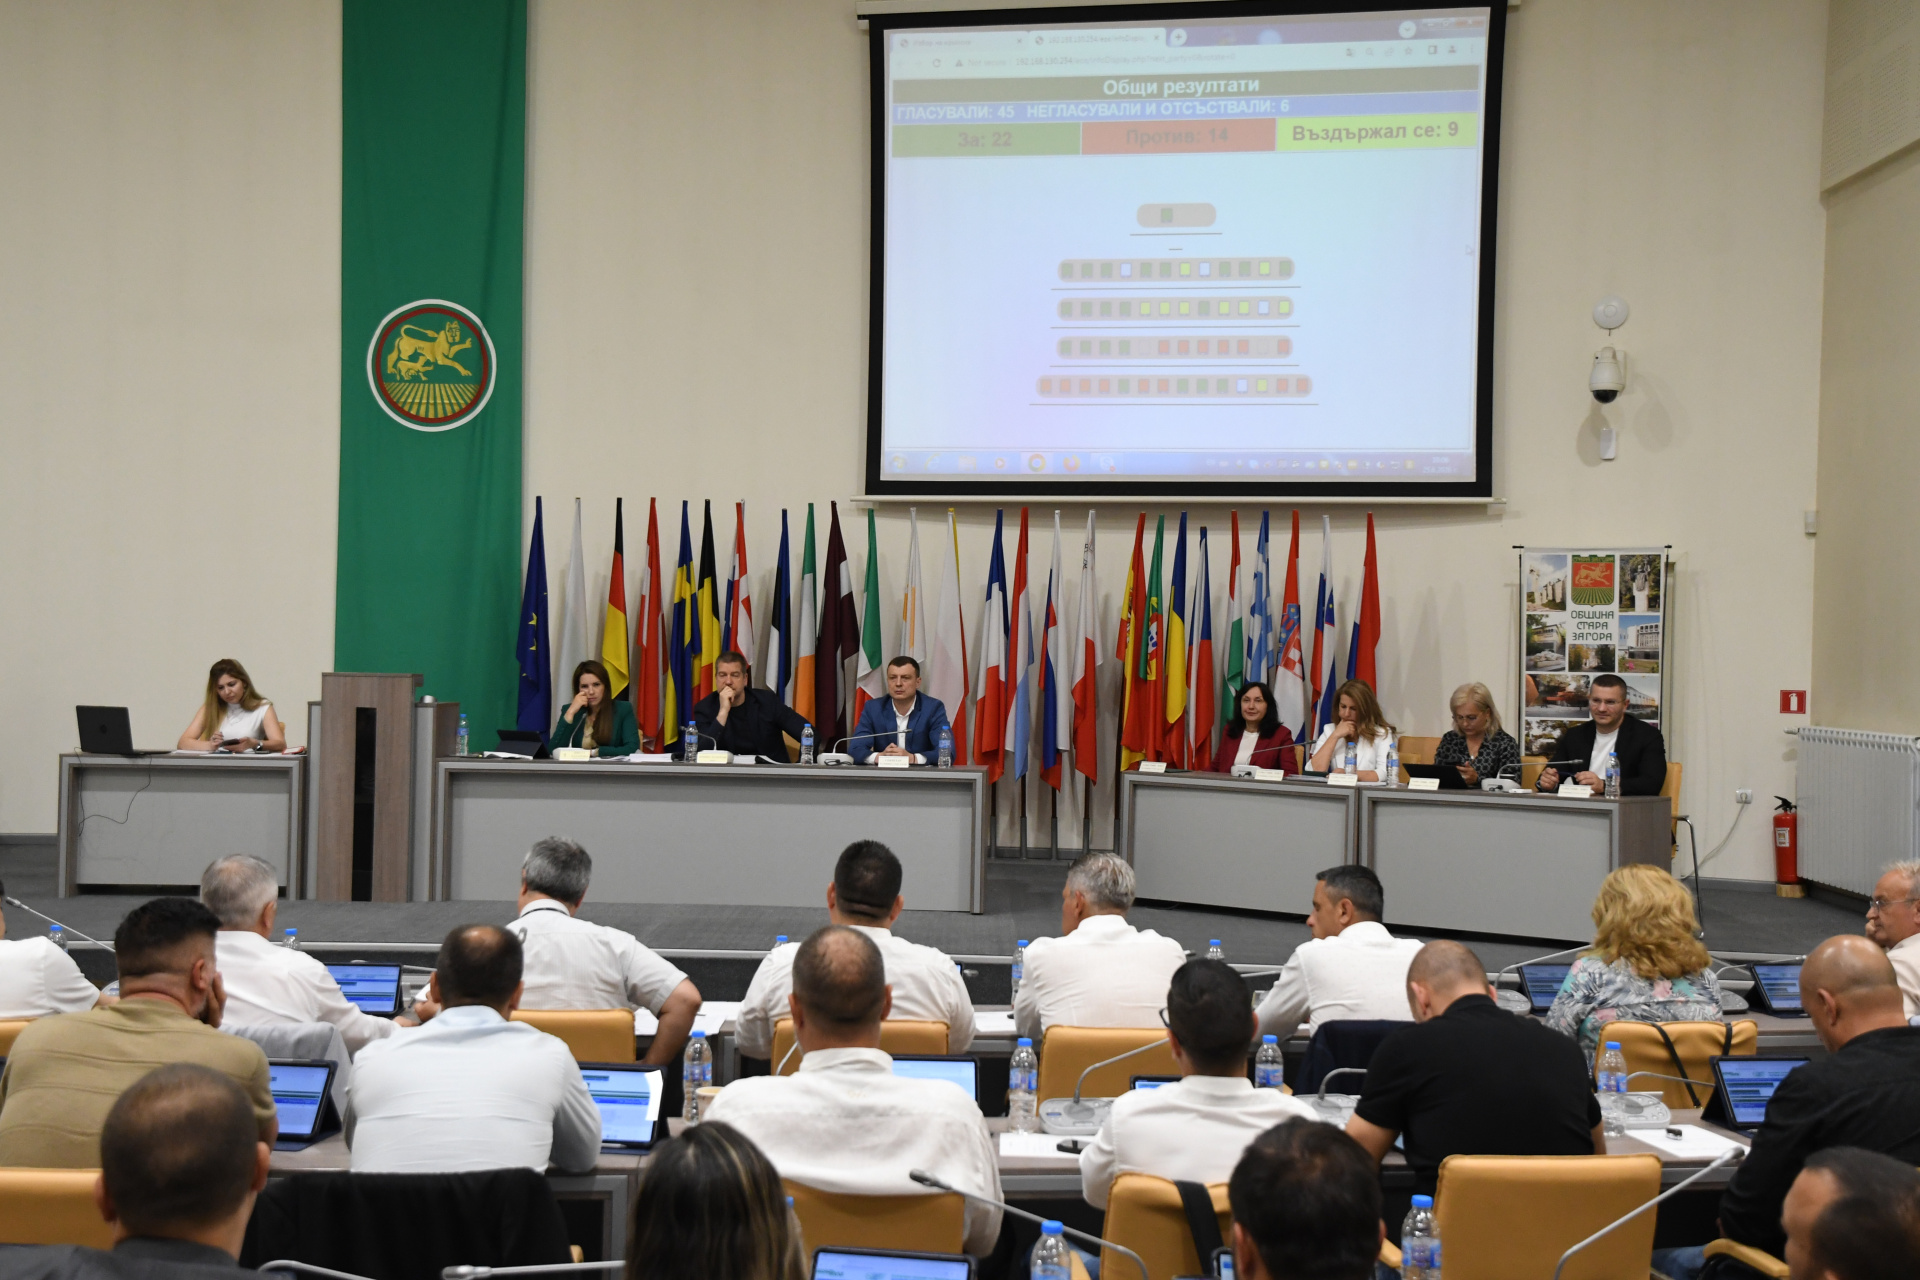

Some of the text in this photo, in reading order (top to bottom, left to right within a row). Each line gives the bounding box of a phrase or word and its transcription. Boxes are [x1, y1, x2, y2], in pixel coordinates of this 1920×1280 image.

[1103, 79, 1260, 97] Общи резултати
[897, 99, 1289, 120] ГЛАСУВАЛИ: 45 НЕГЛАСУВАЛИ И ОТСЪСТВАЛИ: 6
[958, 131, 1012, 148] За: 22
[1126, 127, 1229, 148] Против: 14
[1292, 121, 1459, 144] Въздържал се: 9
[1570, 610, 1614, 619] ОБЩИНА
[1576, 621, 1608, 630] СТАРА
[1572, 632, 1612, 641] ЗАГОРА
